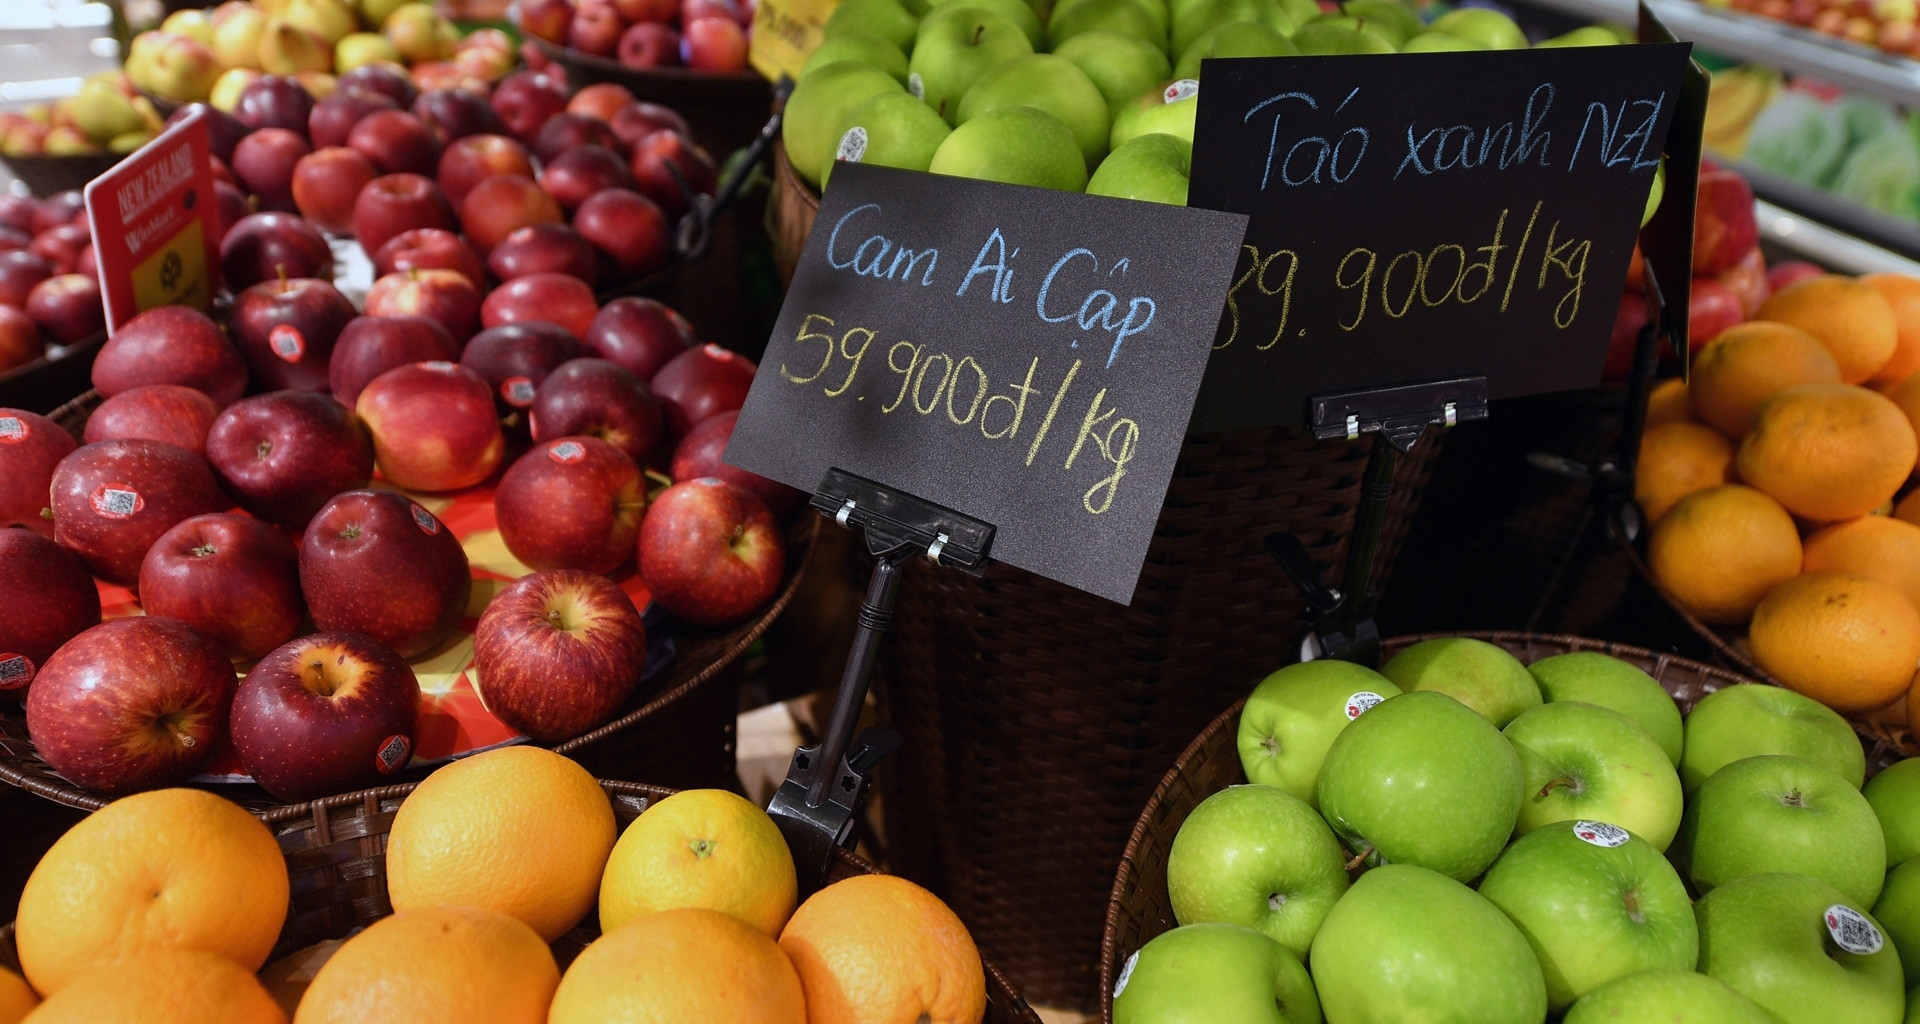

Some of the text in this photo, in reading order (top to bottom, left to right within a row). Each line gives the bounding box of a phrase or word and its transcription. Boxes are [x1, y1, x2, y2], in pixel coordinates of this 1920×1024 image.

[116, 141, 193, 216] NEW ZEALAND
[1394, 82, 1556, 180] xanh
[1567, 90, 1665, 173] NZL
[825, 203, 939, 287] Cam
[1036, 247, 1157, 369] Cập
